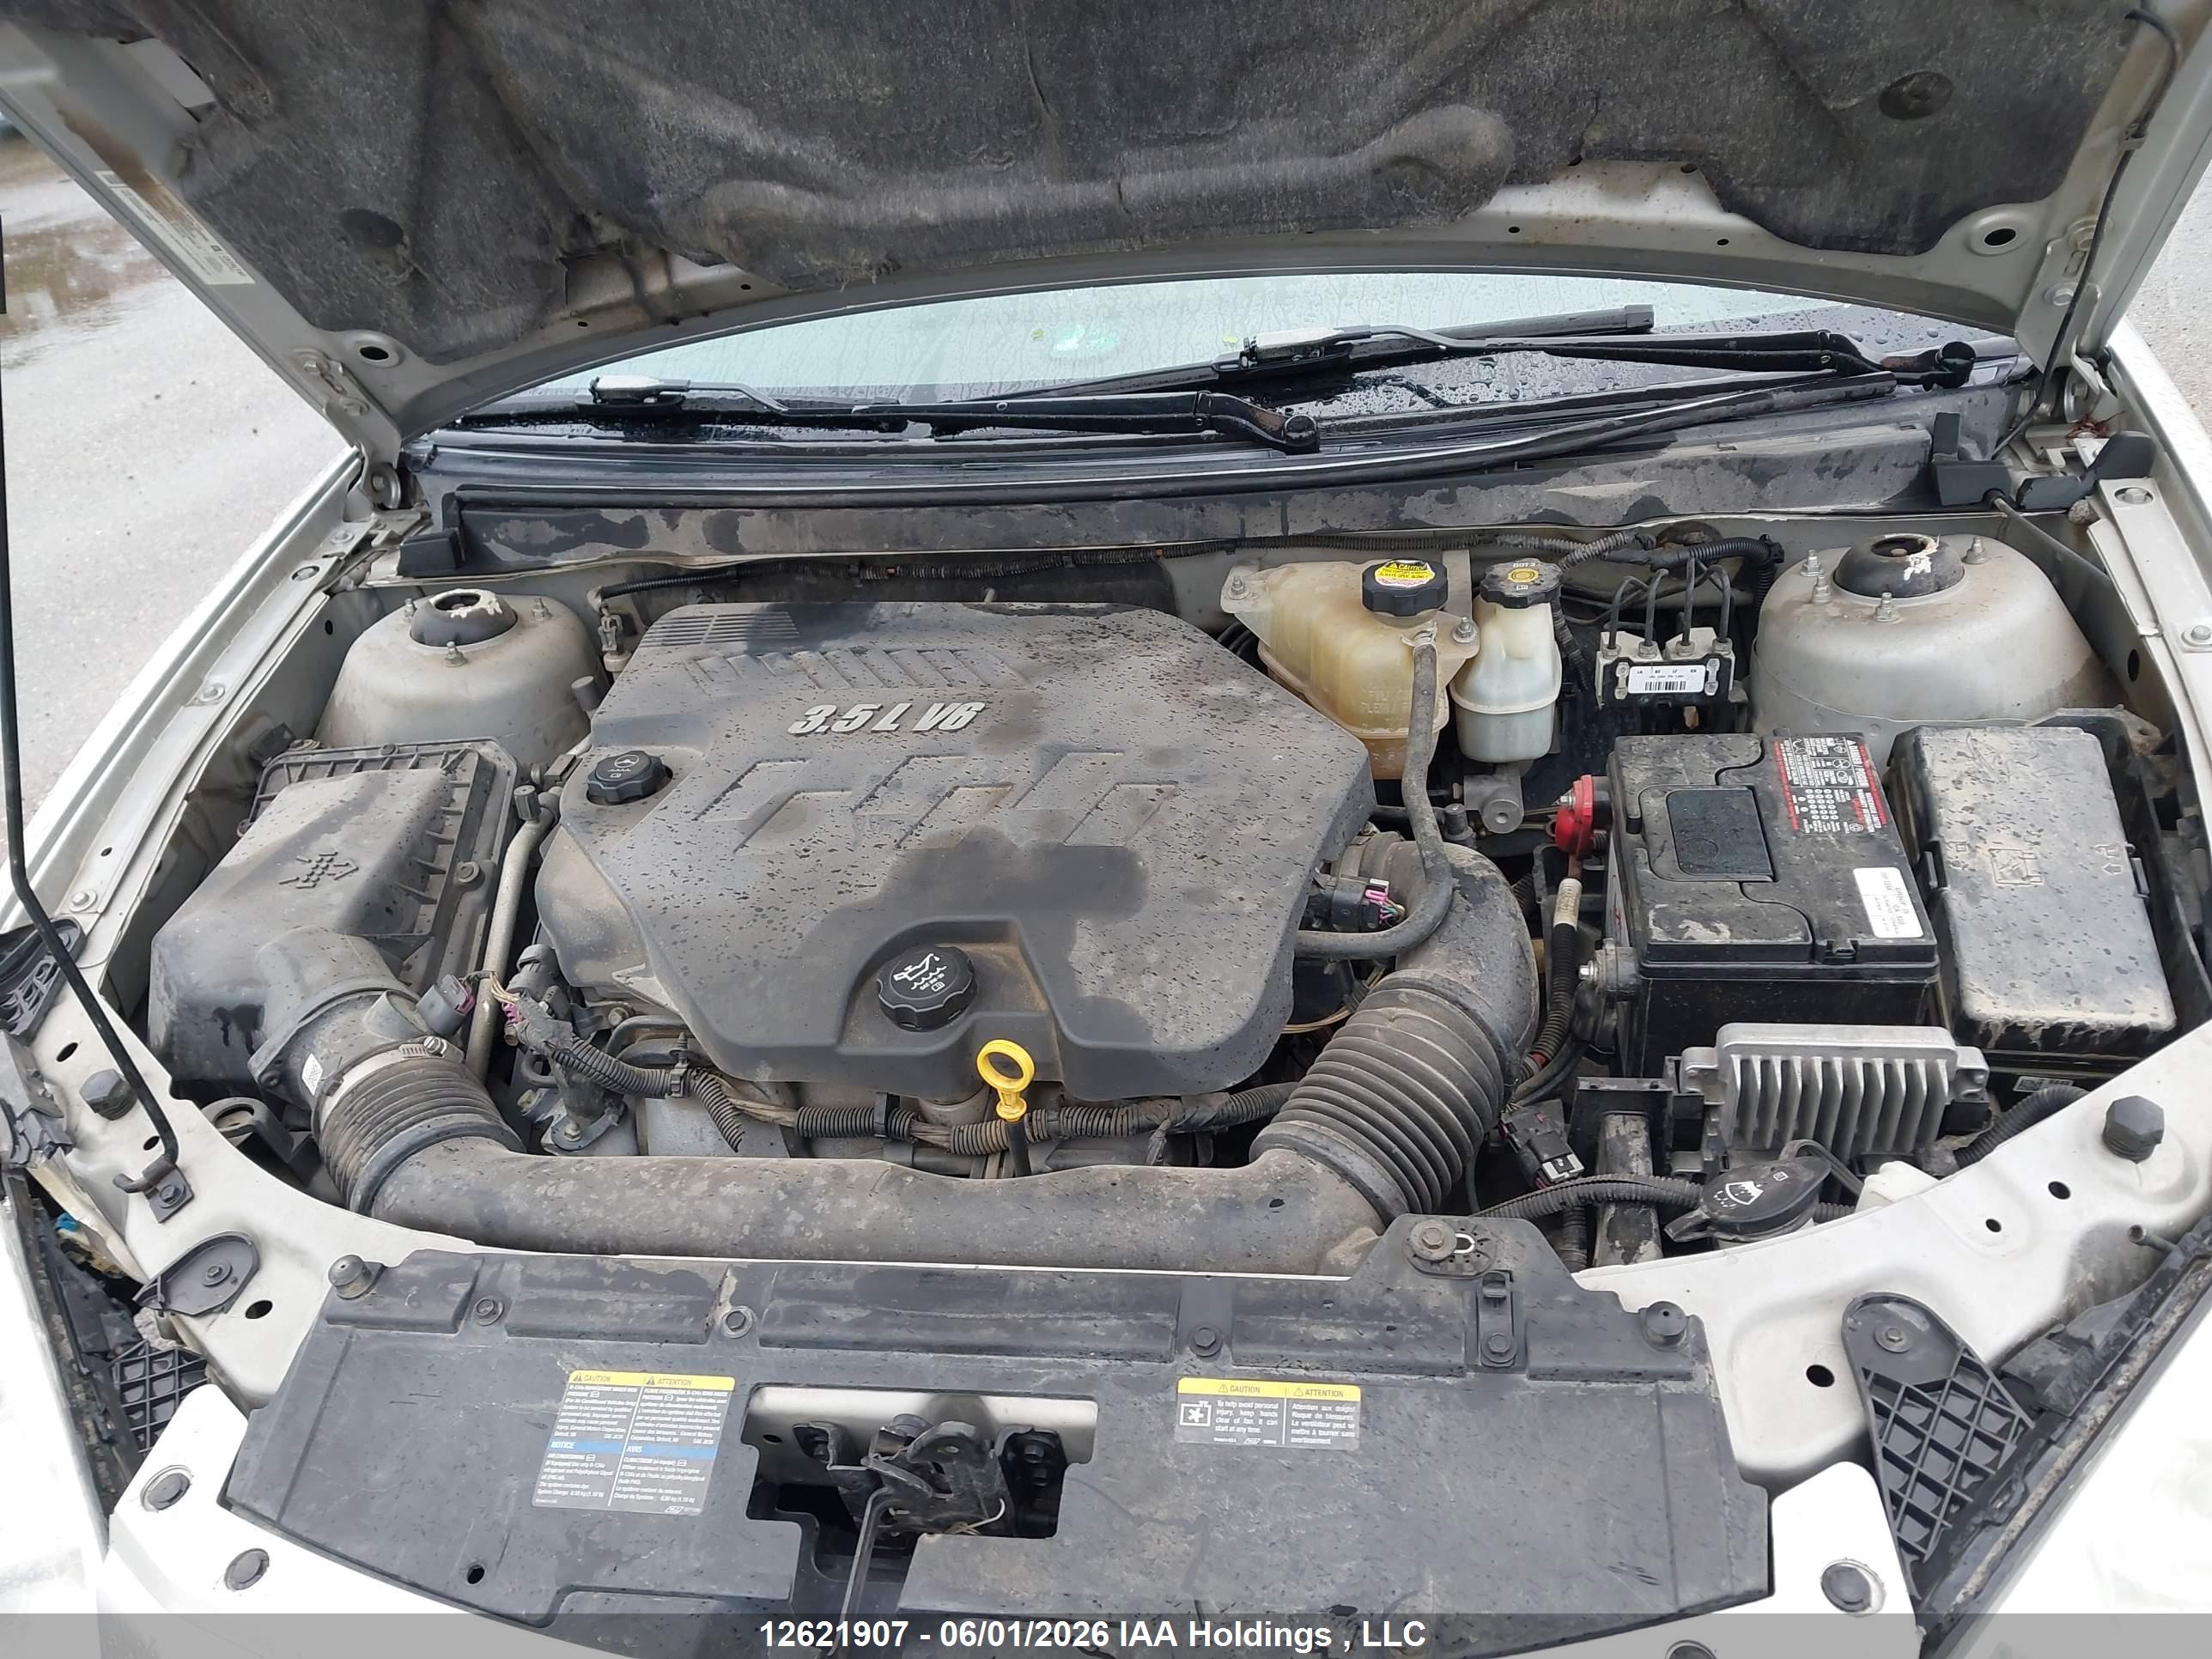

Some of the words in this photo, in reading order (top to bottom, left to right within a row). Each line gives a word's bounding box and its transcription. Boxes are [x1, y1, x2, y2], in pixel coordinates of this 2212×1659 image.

[912, 701, 987, 733] V6
[1230, 1385, 1261, 1394] CAUTION
[1305, 1389, 1344, 1397] ATTENTION
[1291, 1402, 1319, 1411] Attention
[550, 1441, 576, 1449] NOTICE
